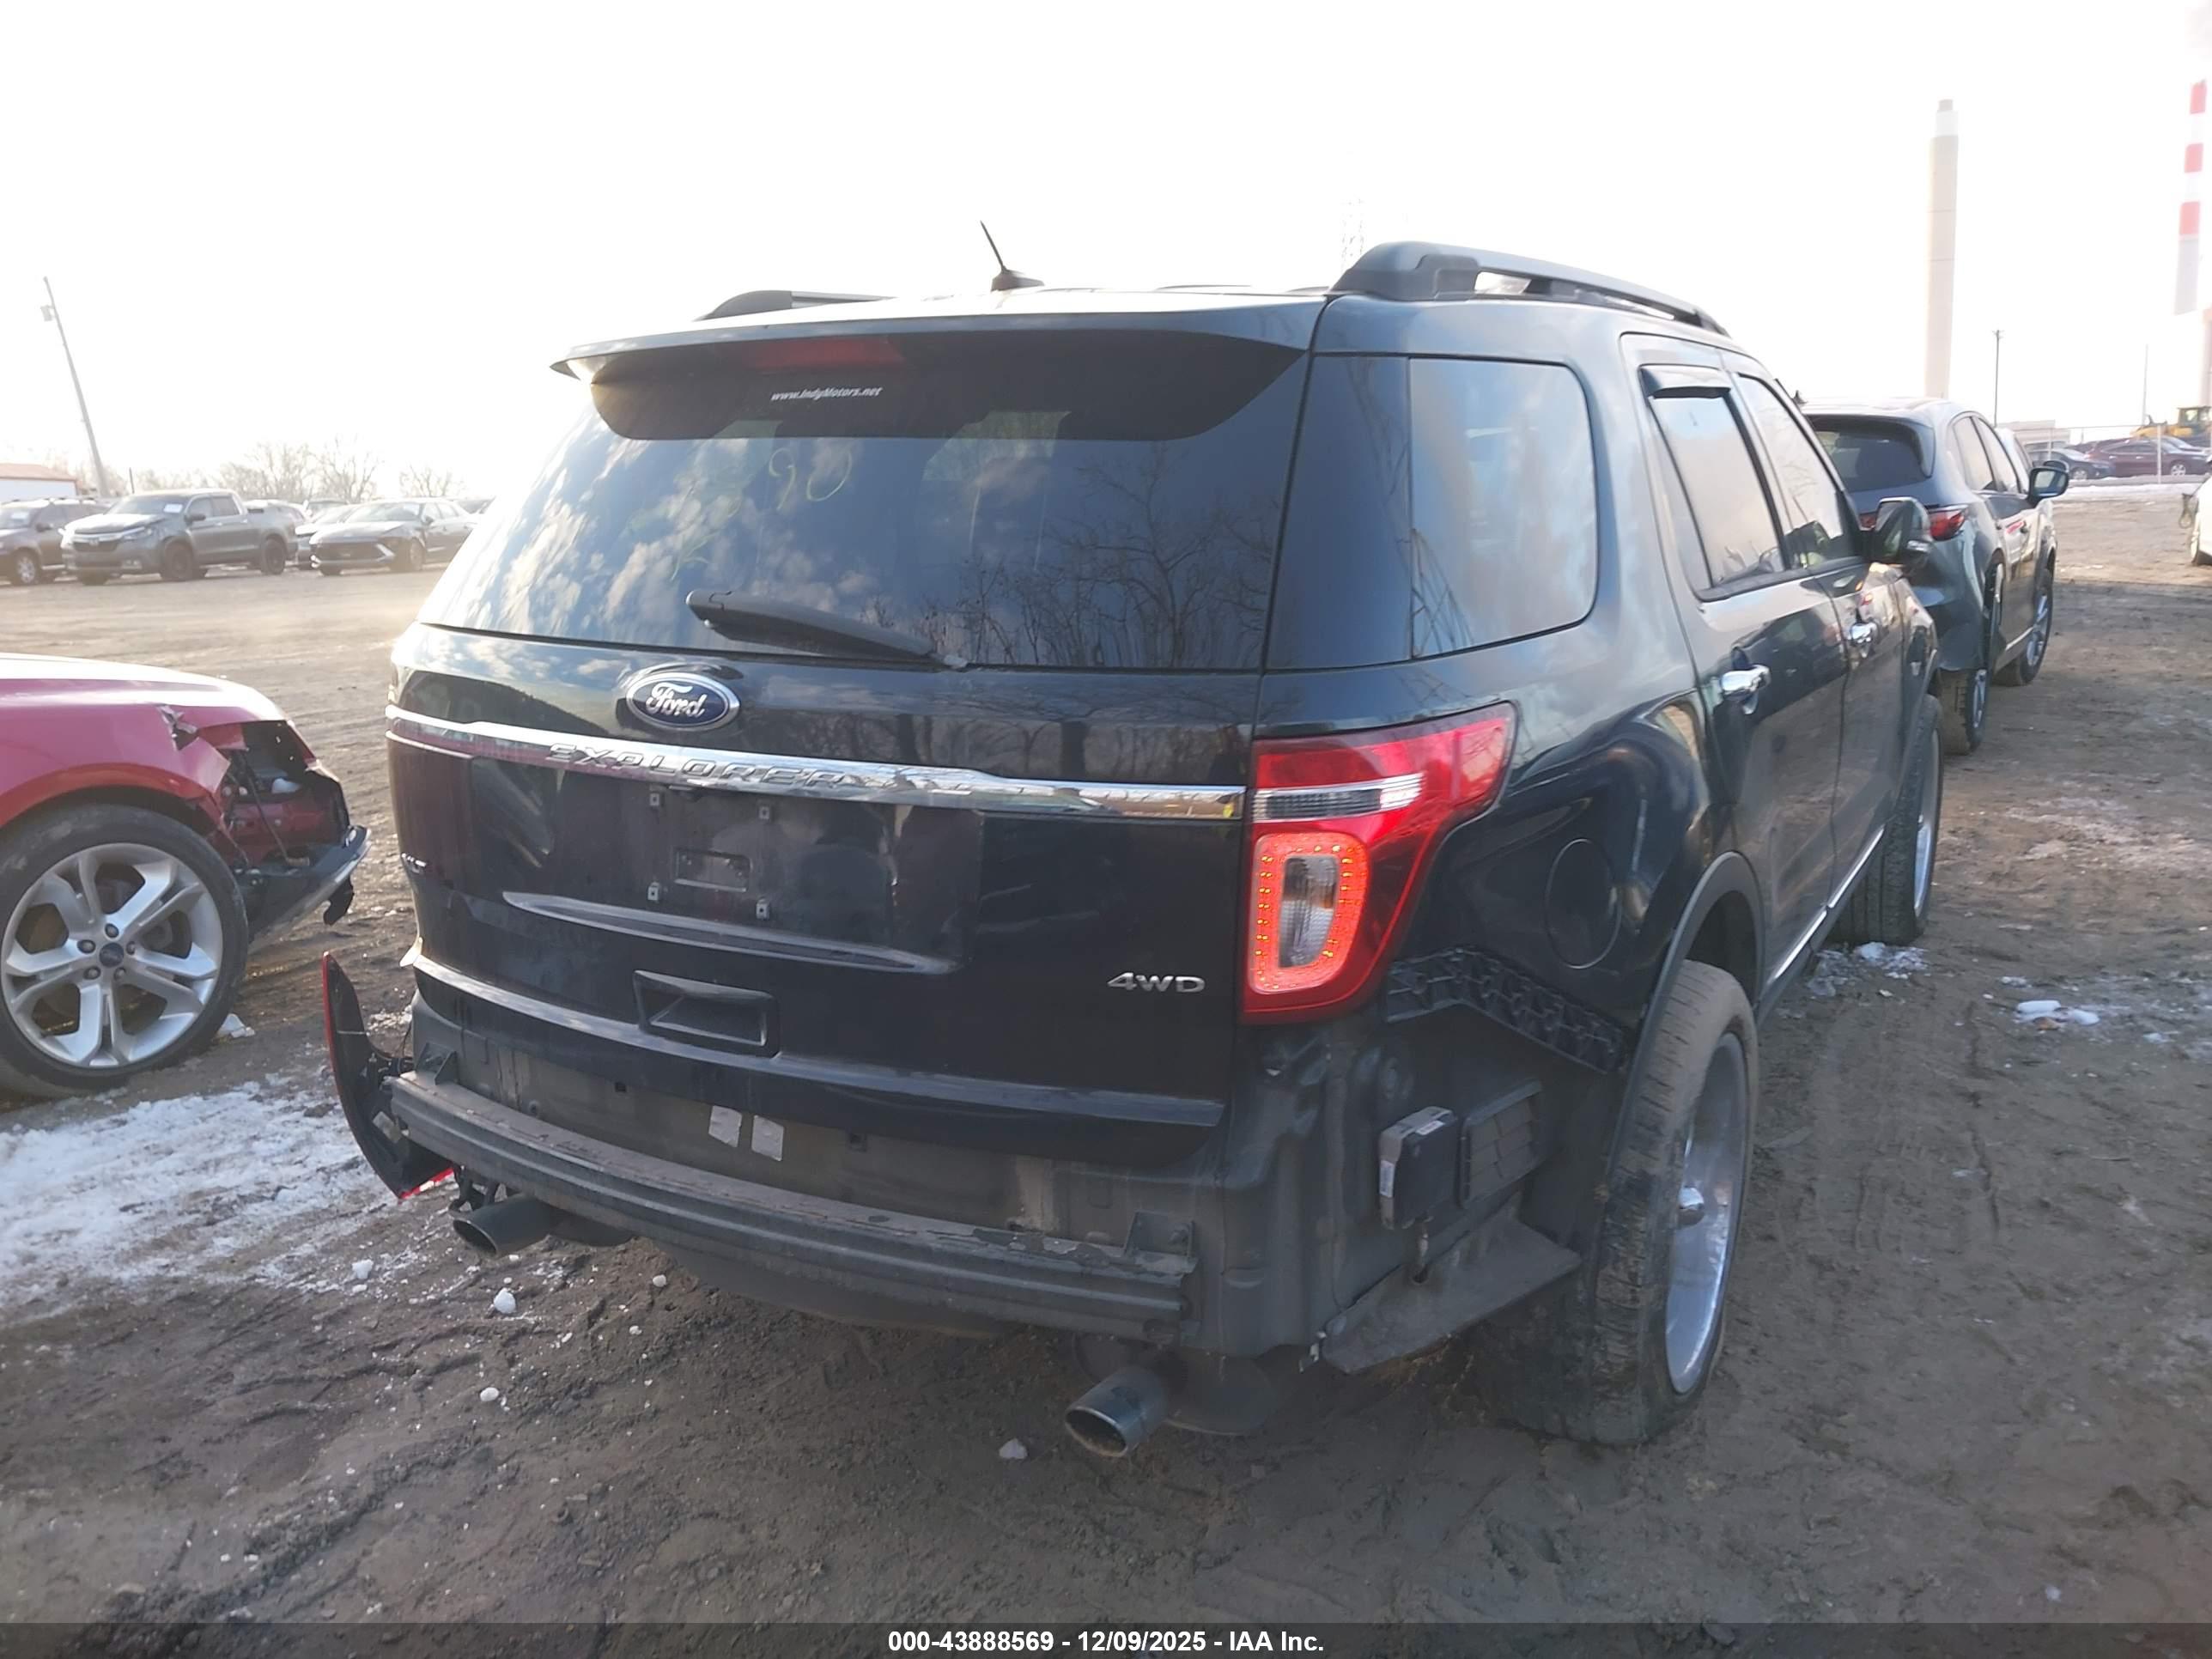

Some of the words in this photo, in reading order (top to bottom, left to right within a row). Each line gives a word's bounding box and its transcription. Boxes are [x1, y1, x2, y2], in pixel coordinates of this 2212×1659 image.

[645, 682, 708, 717] Ford
[546, 742, 847, 789] EXPLORER
[1107, 972, 1206, 993] 4WD
